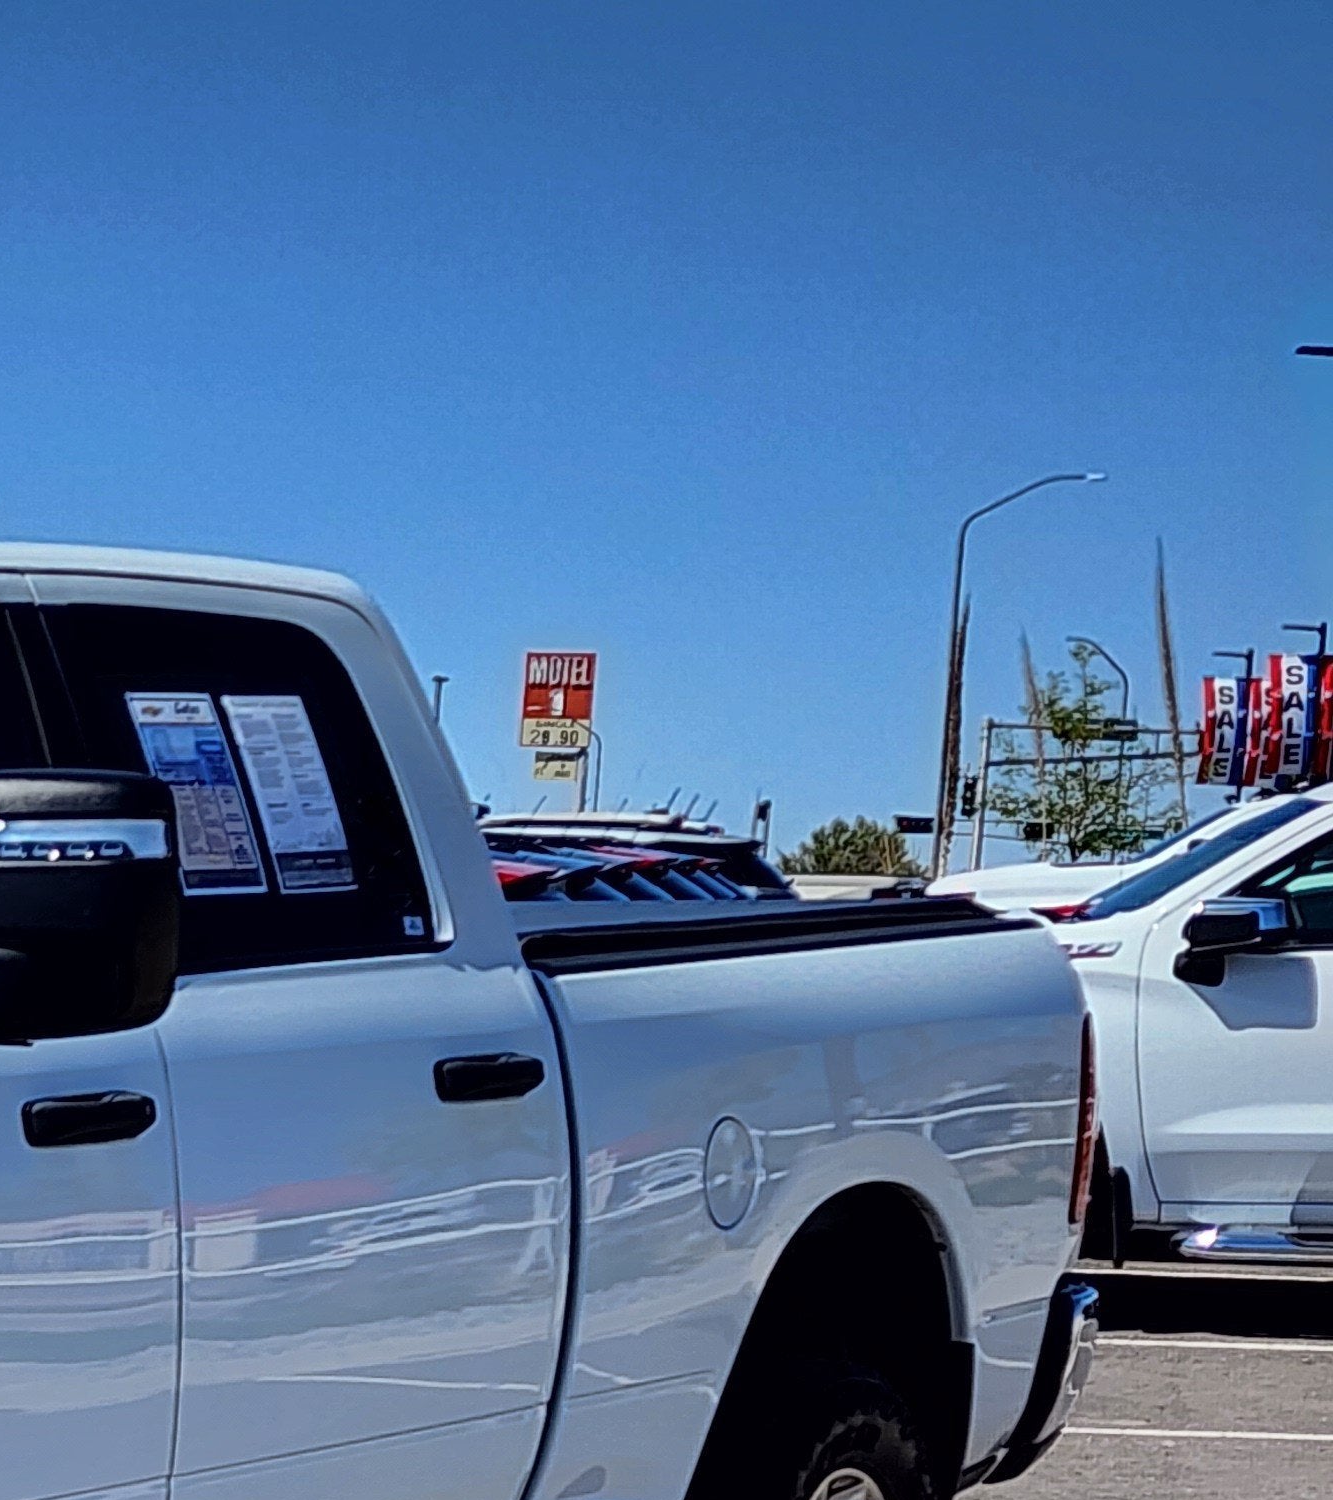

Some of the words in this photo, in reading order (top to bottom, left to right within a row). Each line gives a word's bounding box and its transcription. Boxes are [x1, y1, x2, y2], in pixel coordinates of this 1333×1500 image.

[528, 656, 592, 686] MOTEL
[1283, 665, 1305, 765] SALE
[1212, 686, 1236, 778] SALE
